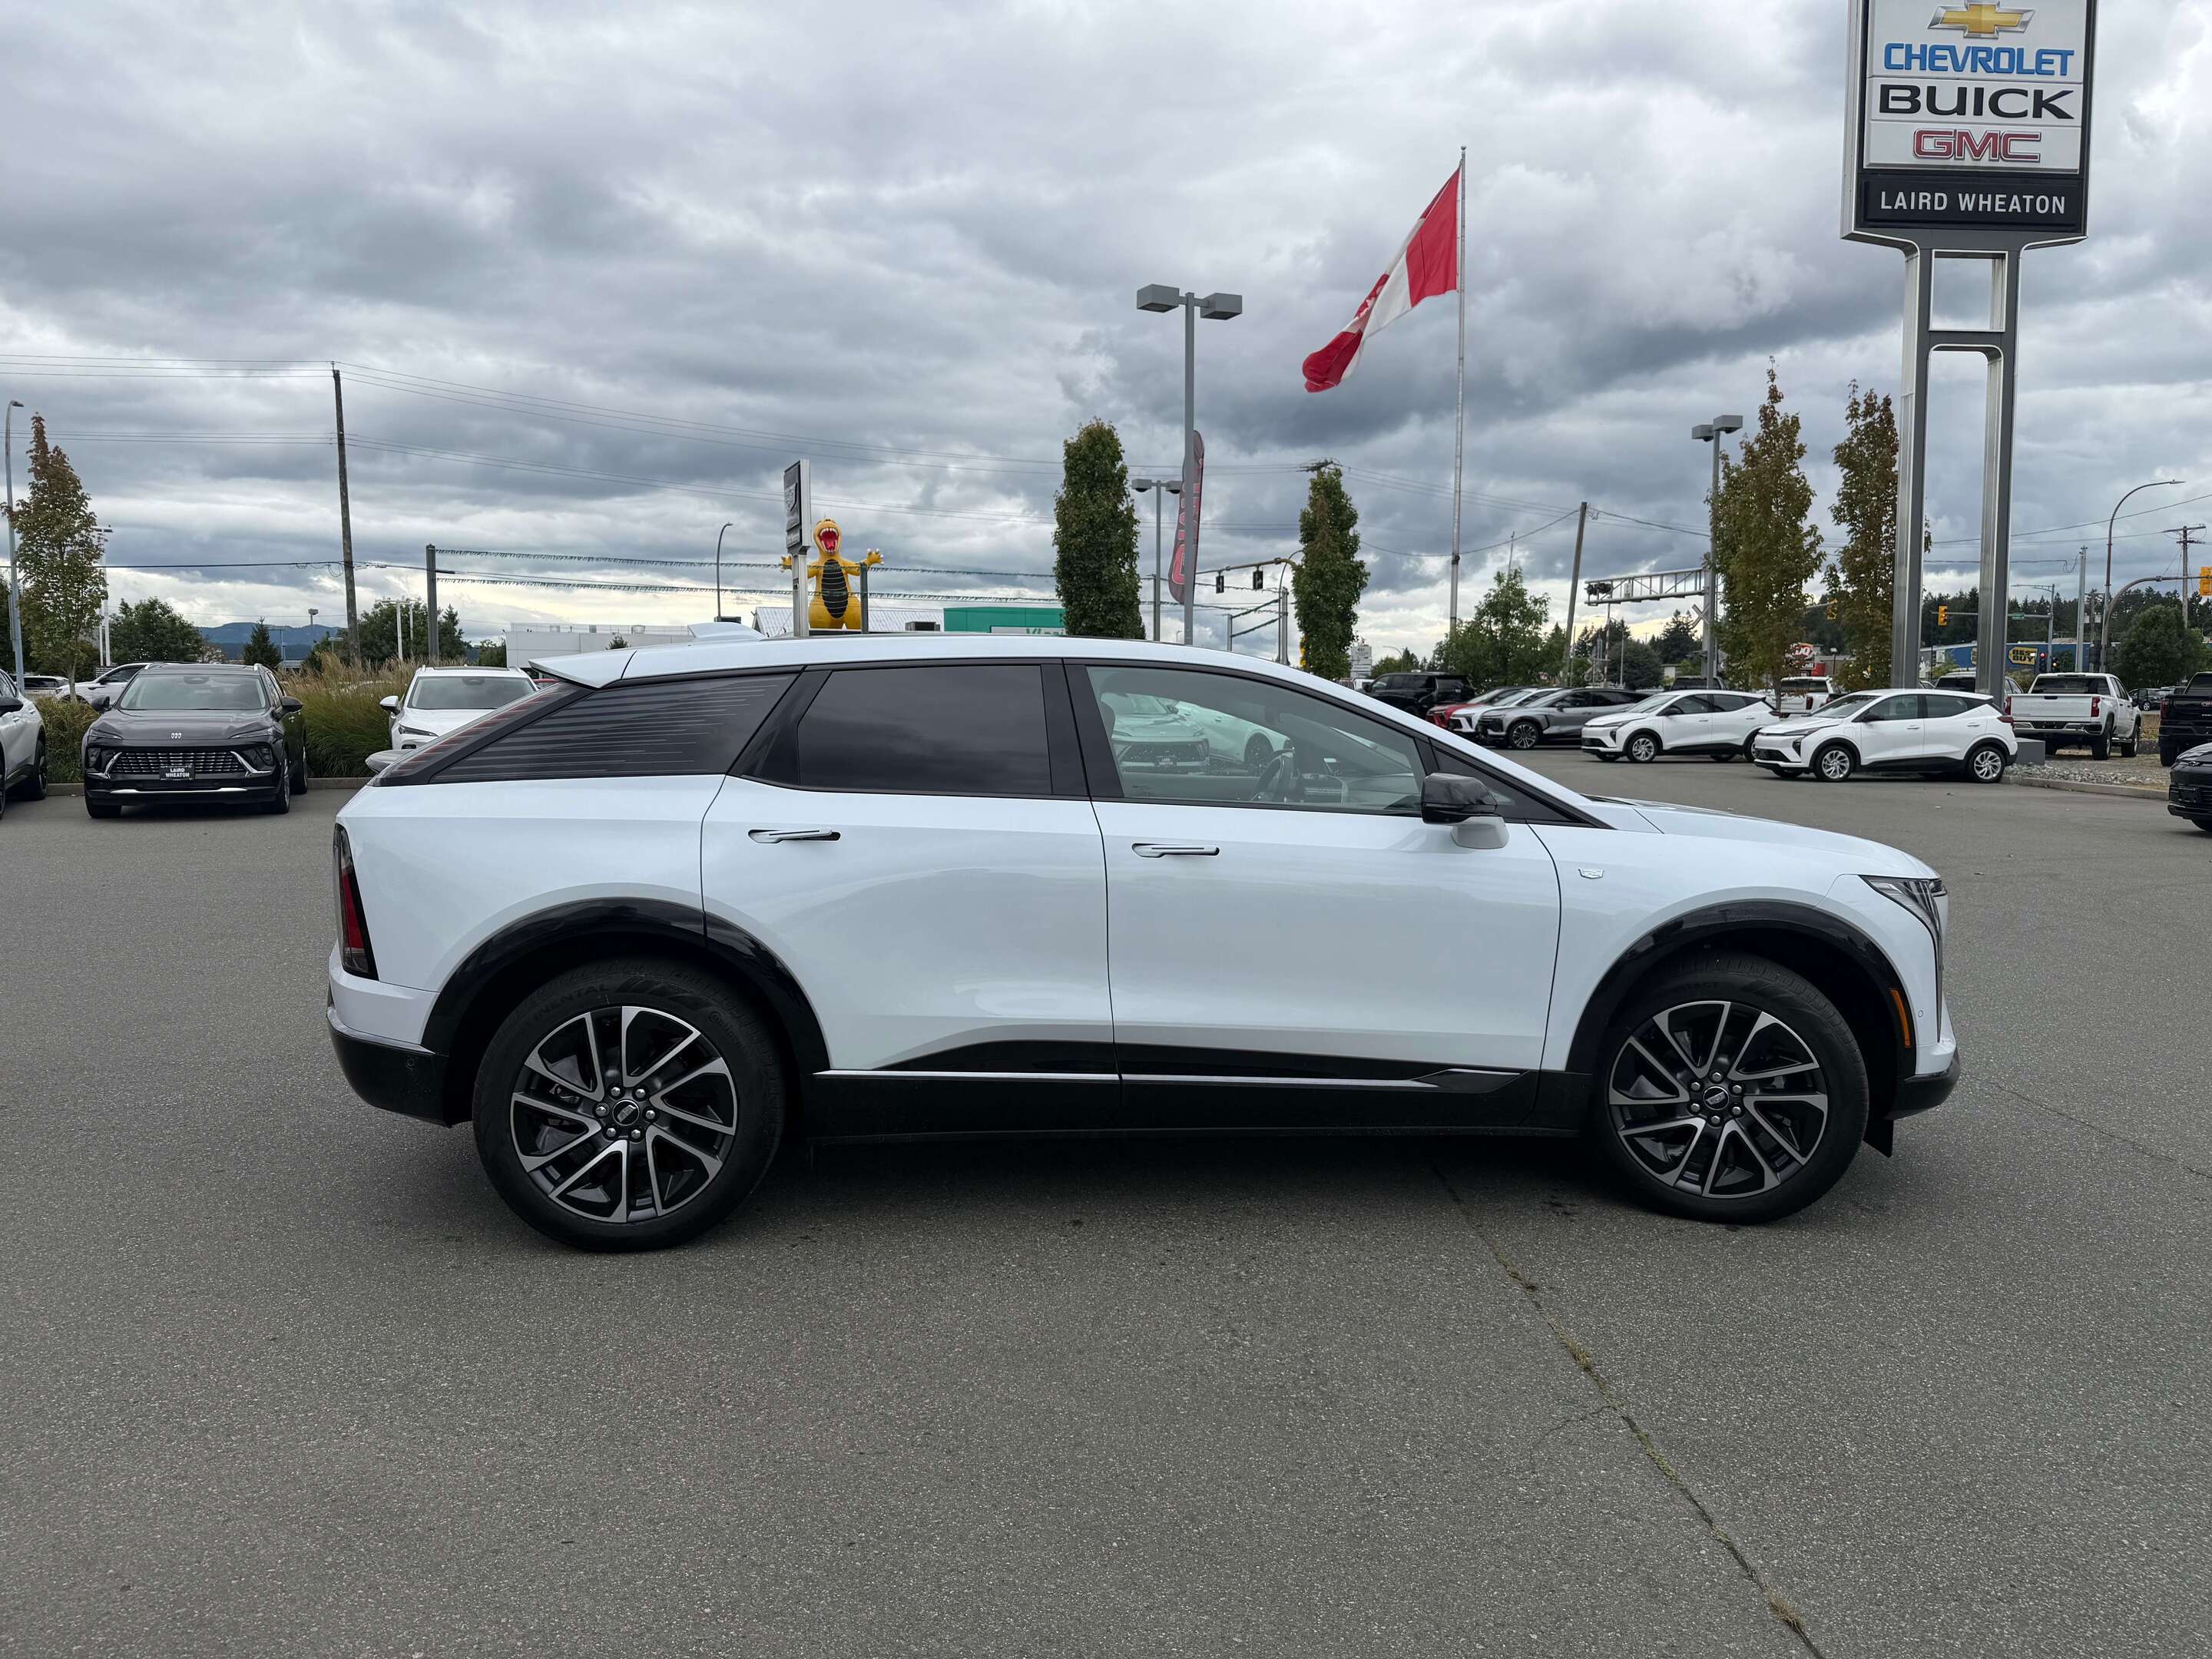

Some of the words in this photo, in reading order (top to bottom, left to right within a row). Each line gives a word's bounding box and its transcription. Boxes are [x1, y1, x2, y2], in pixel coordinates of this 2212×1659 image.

[1884, 43, 2075, 75] CHEVROLET
[1879, 84, 2075, 119] BUICK
[1913, 129, 2041, 162] GMC
[1881, 191, 1948, 211] LAIRD
[1959, 194, 2065, 214] WHEATON
